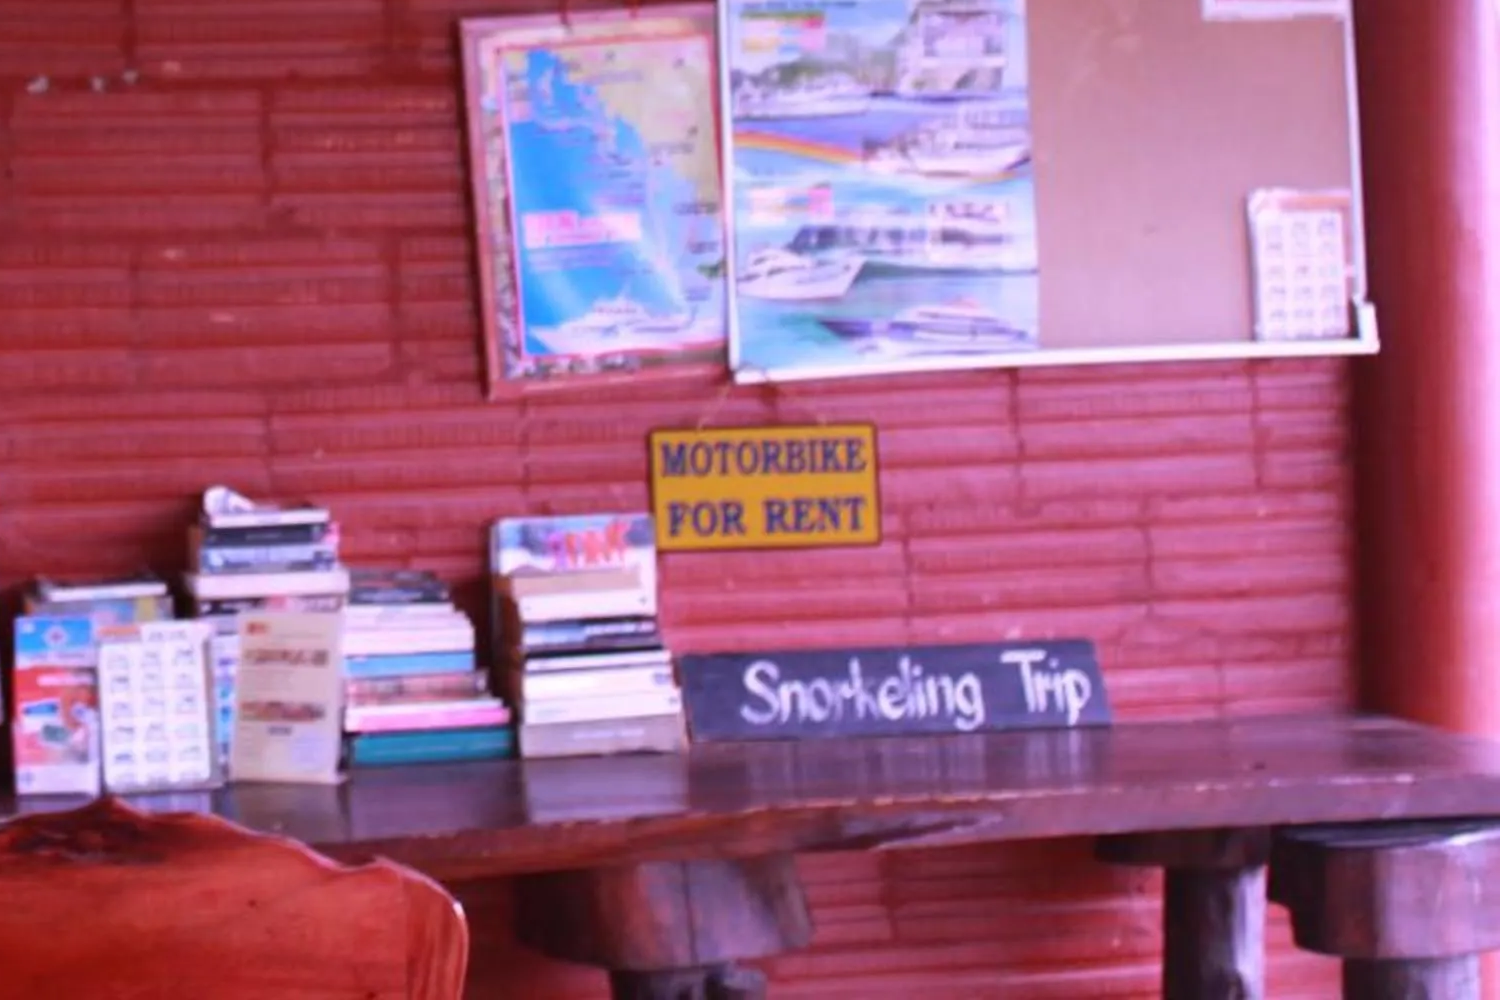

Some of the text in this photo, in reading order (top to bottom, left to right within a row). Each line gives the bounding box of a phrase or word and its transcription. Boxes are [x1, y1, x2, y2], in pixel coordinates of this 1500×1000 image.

[660, 437, 867, 478] MOTORBIKE
[667, 497, 867, 537] FOR RENT
[740, 648, 1091, 731] Snorkeling Trip
